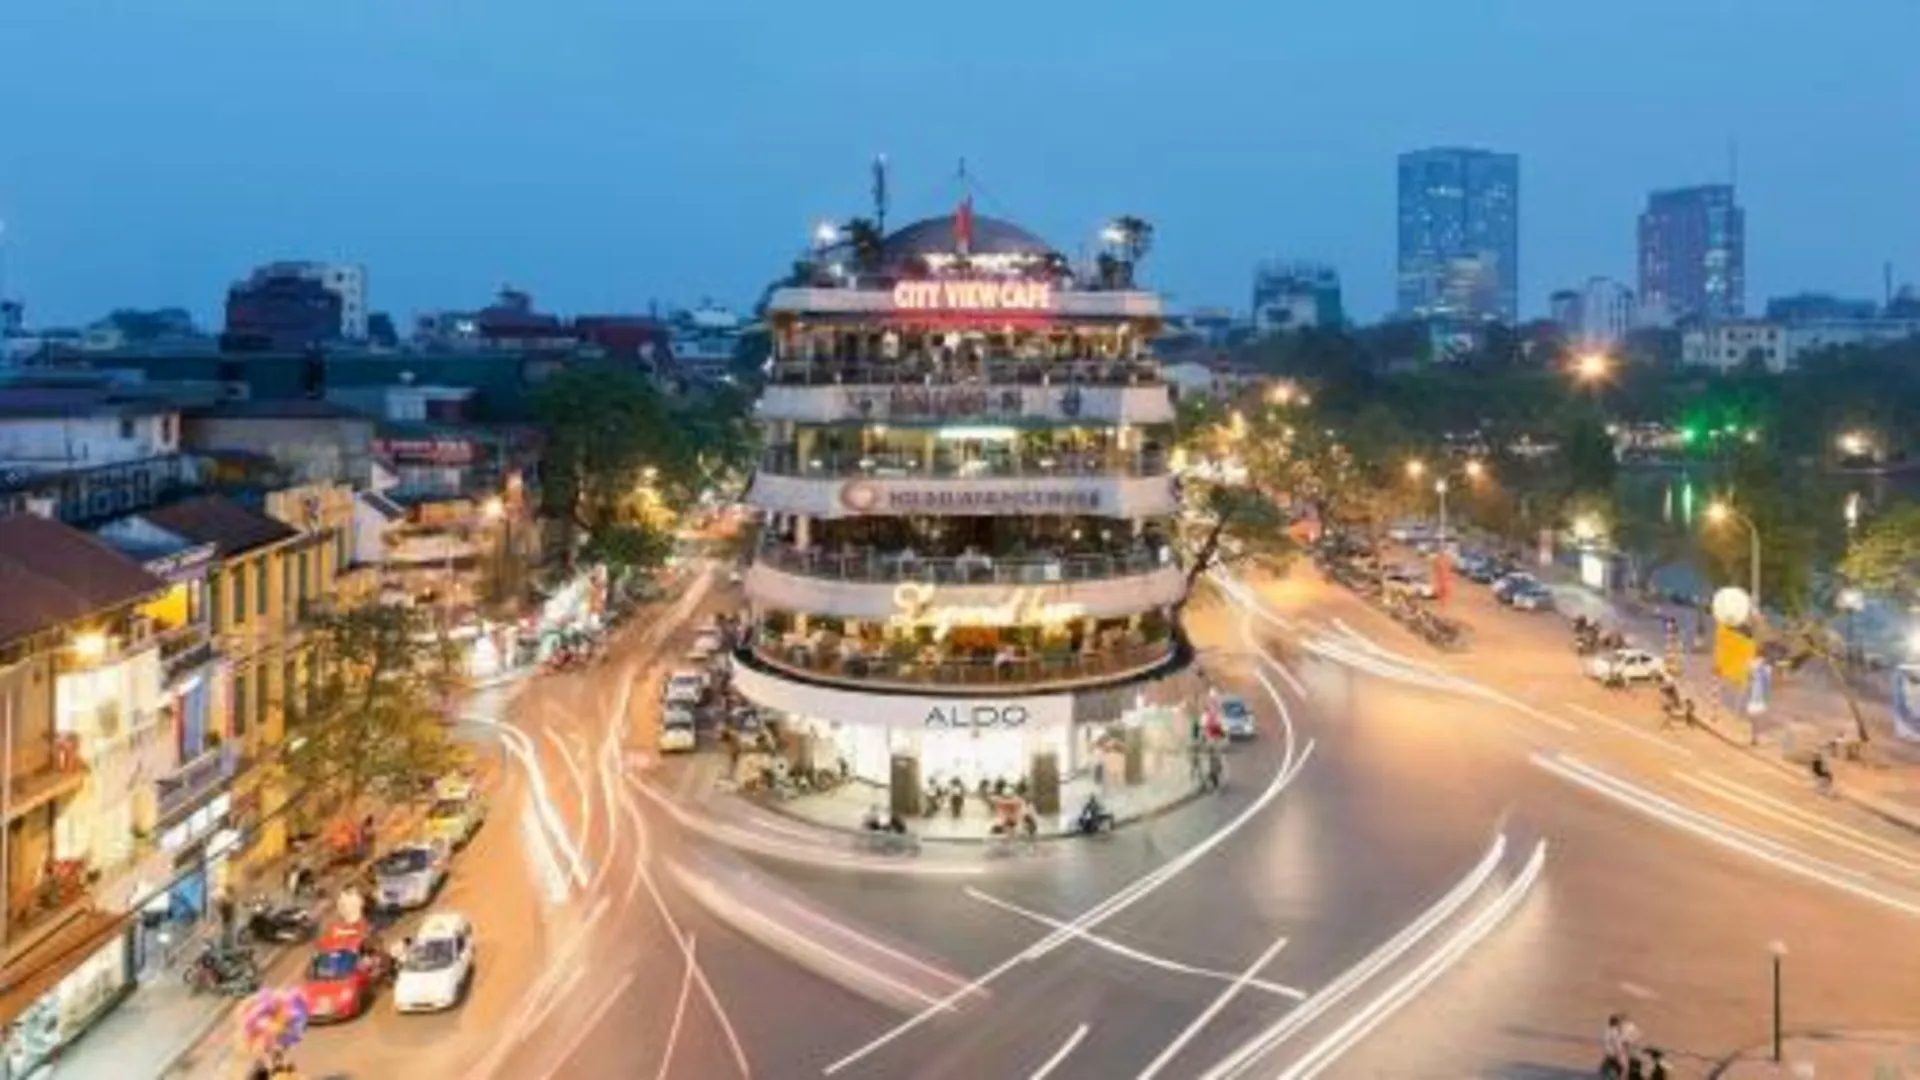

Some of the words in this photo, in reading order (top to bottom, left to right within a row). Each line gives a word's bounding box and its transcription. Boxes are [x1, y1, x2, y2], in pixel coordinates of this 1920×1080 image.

[894, 279, 942, 309] CITY
[944, 279, 1000, 309] VIEW
[924, 705, 1028, 728] ALDO
